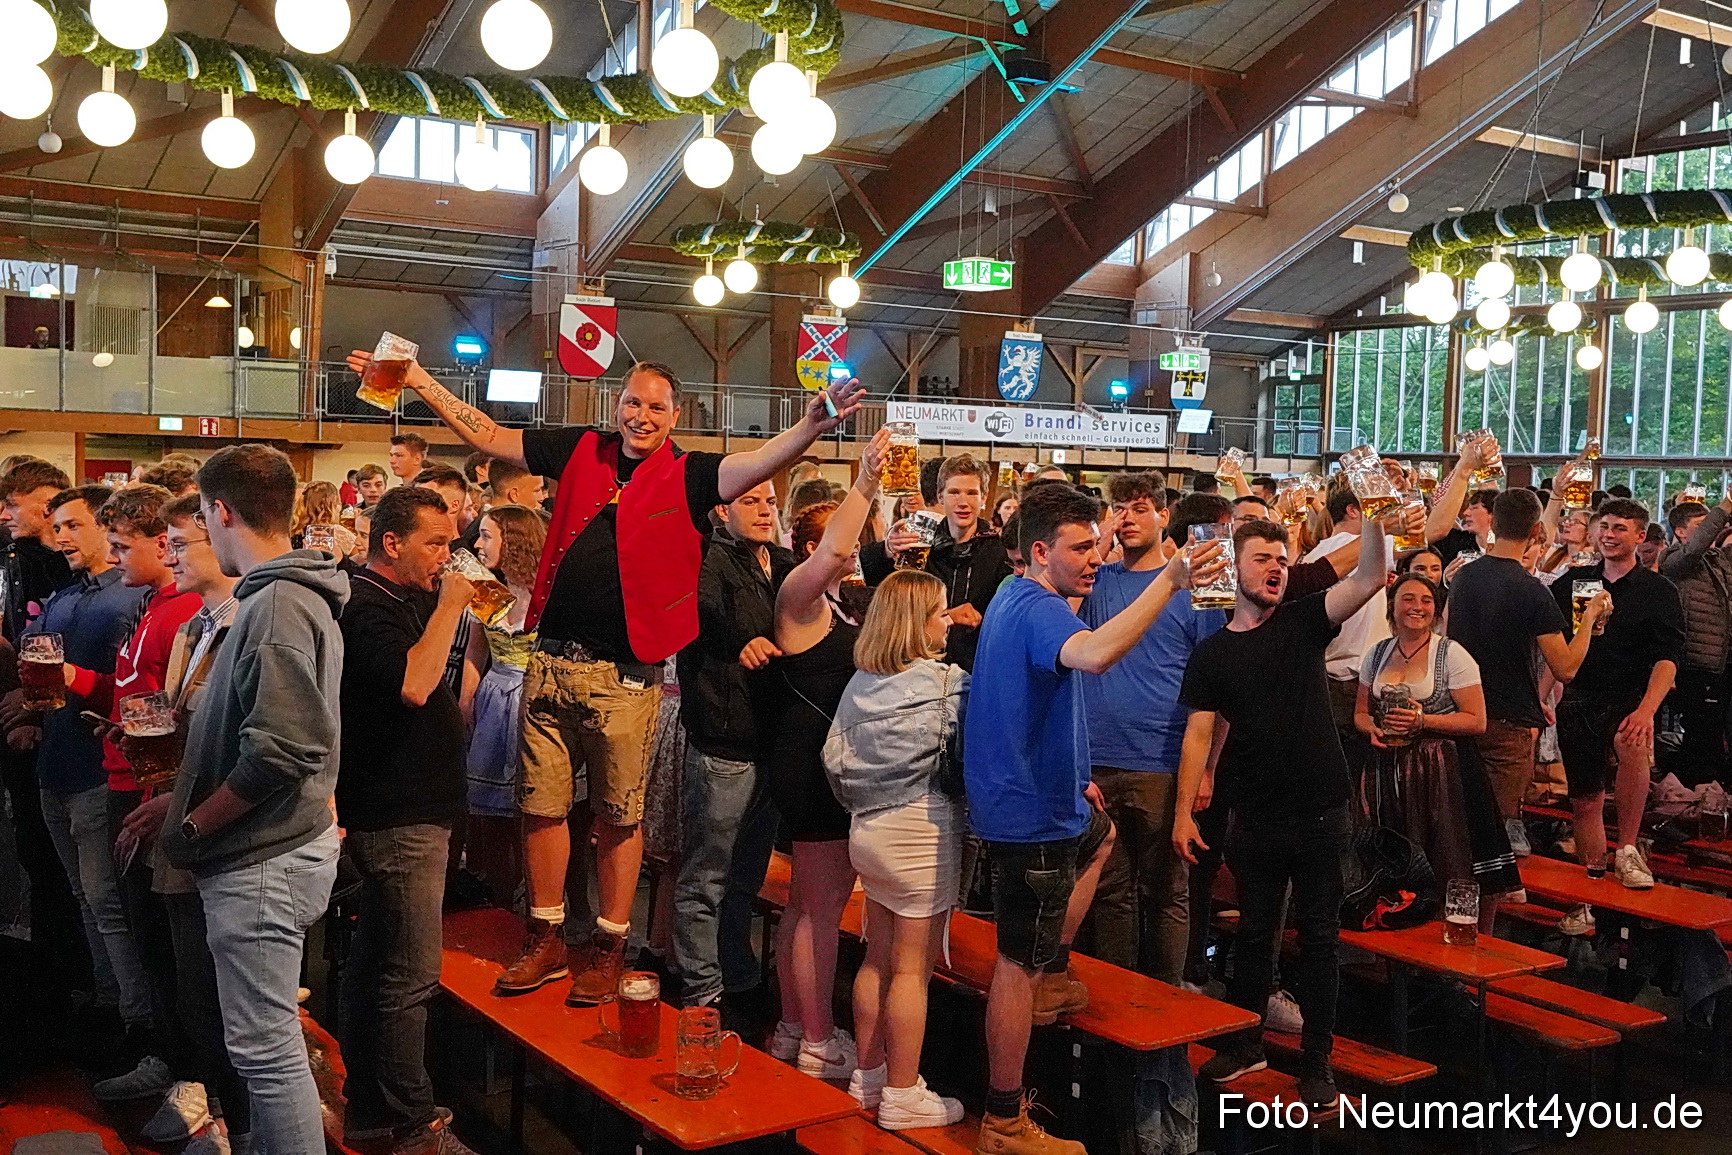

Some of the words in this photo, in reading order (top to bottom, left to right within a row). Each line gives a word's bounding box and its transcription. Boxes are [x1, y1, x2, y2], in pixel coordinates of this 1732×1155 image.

[896, 405, 965, 422] NEUMARKT
[1092, 417, 1160, 433] services
[1024, 432, 1058, 440] einfach
[1061, 434, 1093, 442] schnell
[1103, 435, 1144, 444] Glasfaser
[1146, 437, 1160, 445] DSL
